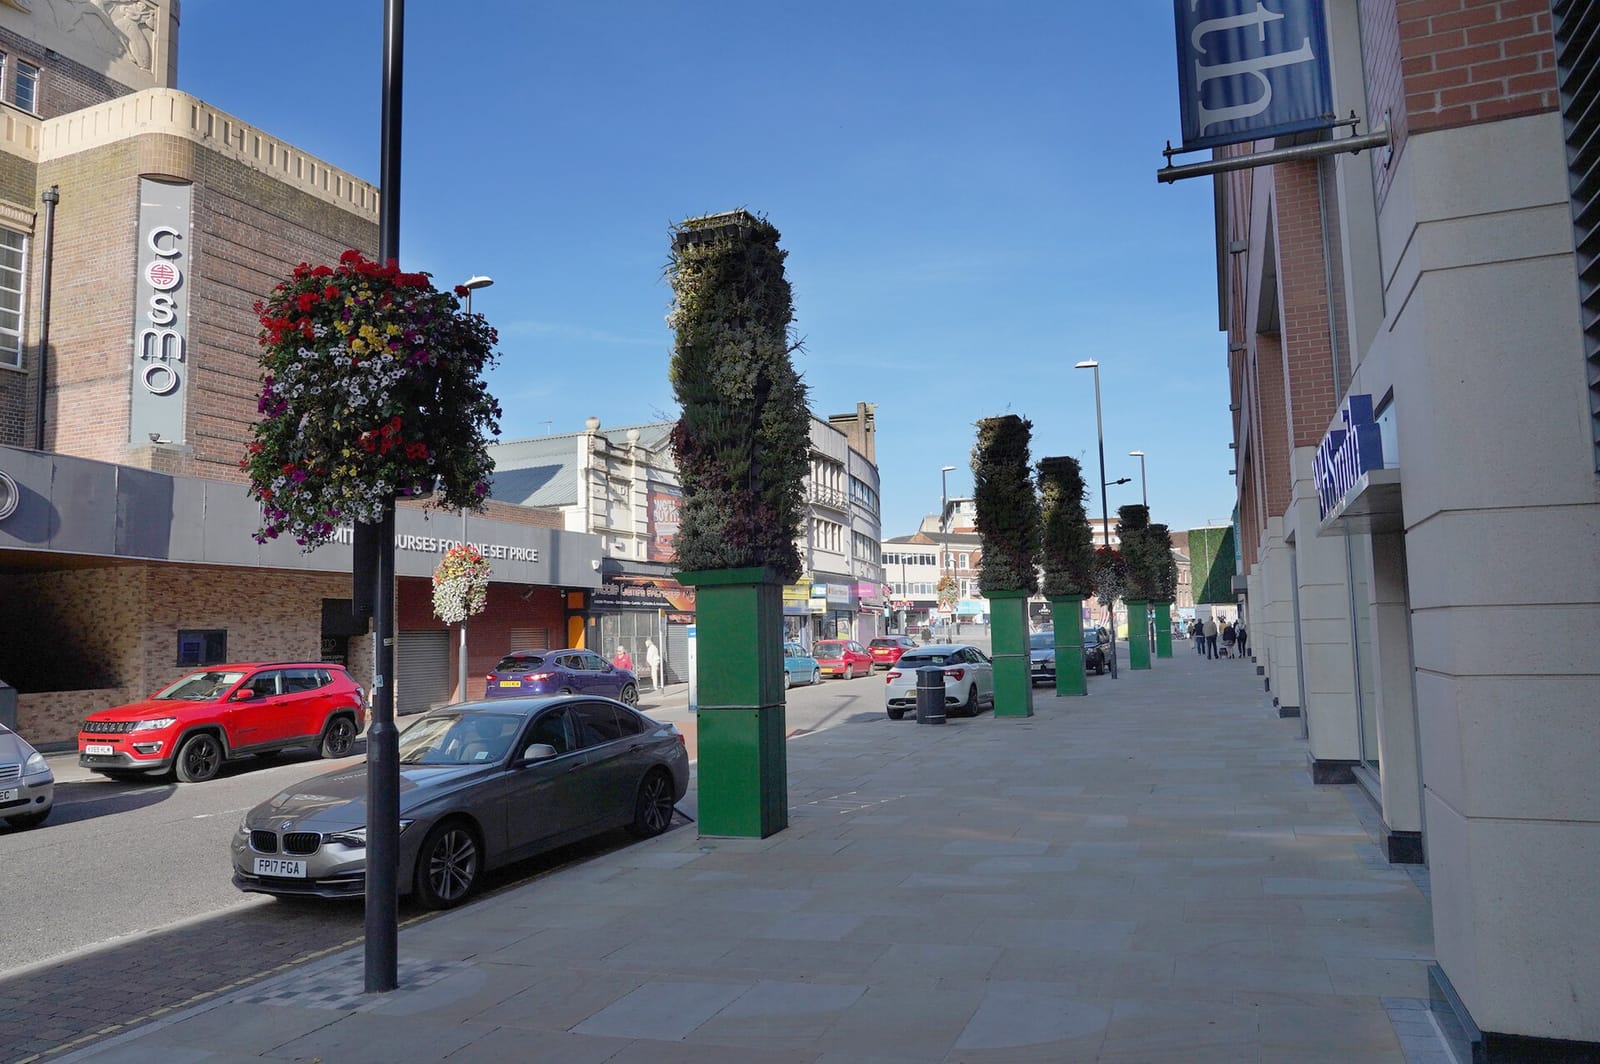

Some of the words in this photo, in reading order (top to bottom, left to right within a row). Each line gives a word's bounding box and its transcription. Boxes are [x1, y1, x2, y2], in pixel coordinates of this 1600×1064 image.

[1190, 0, 1315, 137] th
[394, 534, 436, 551] URSES
[490, 544, 509, 559] SET
[510, 546, 538, 561] PRICE
[258, 859, 279, 873] FP17
[280, 861, 300, 875] FGA
